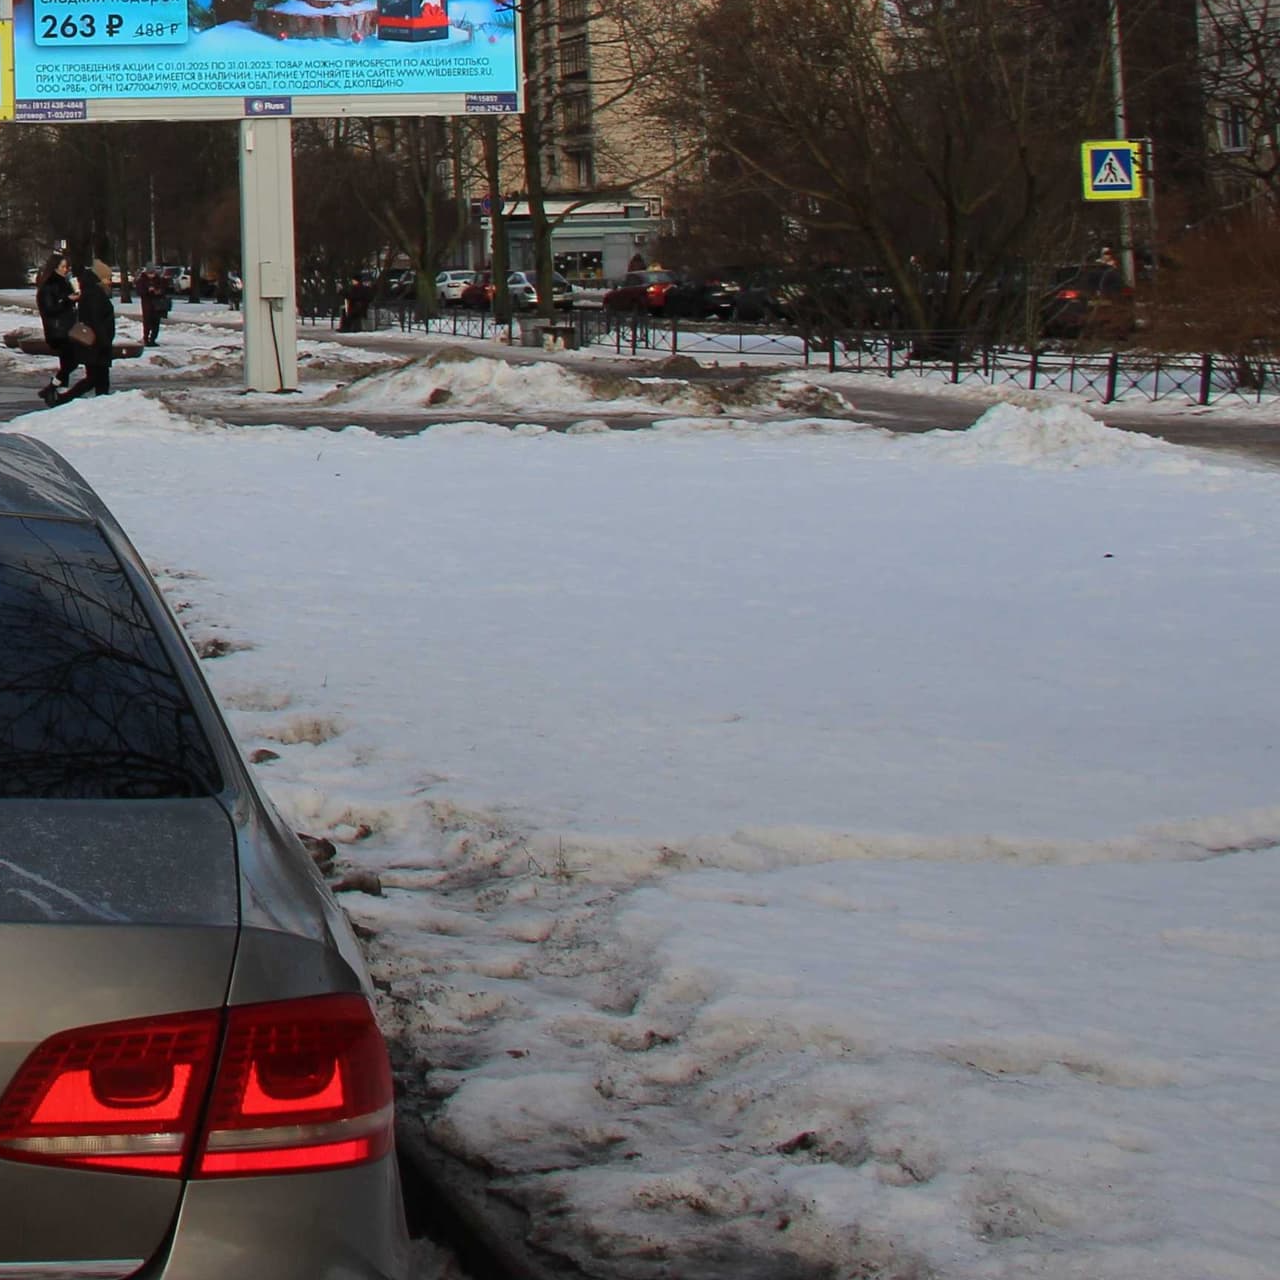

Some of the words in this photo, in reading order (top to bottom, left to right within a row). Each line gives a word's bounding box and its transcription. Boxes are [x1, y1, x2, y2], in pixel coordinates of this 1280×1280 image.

[41, 14, 96, 39] 263
[105, 14, 124, 38] ₽
[134, 22, 165, 38] 488
[36, 64, 60, 73] СРОК
[62, 63, 120, 73] ПРОВЕДЕНИЯ
[122, 63, 155, 72] АКЦИИ
[157, 62, 164, 71] С
[165, 61, 209, 71] 01.01.2025
[211, 61, 226, 70] ПО
[276, 60, 302, 69] ТОВАР
[304, 59, 342, 69] МОЖНО
[345, 58, 401, 67] ПРИОБРЕСТИ
[403, 58, 417, 67] ПО
[420, 57, 451, 67] АКЦИИ
[454, 57, 489, 66] ТОЛЬКО
[36, 74, 54, 83] ПРИ
[106, 73, 124, 82] ЧТО
[126, 73, 153, 81] ТОВАР
[155, 71, 195, 81] ИМЕЕТСЯ
[197, 71, 203, 80] В
[254, 70, 298, 80] НАЛИЧИЕ
[299, 68, 350, 79] УТОЧНЯЙТЕ
[352, 69, 365, 78] НА
[367, 67, 394, 78] САЙТЕ
[36, 84, 60, 93] ООО
[89, 83, 113, 92] ОГРН
[182, 80, 245, 90] МОСКОВСКАЯ
